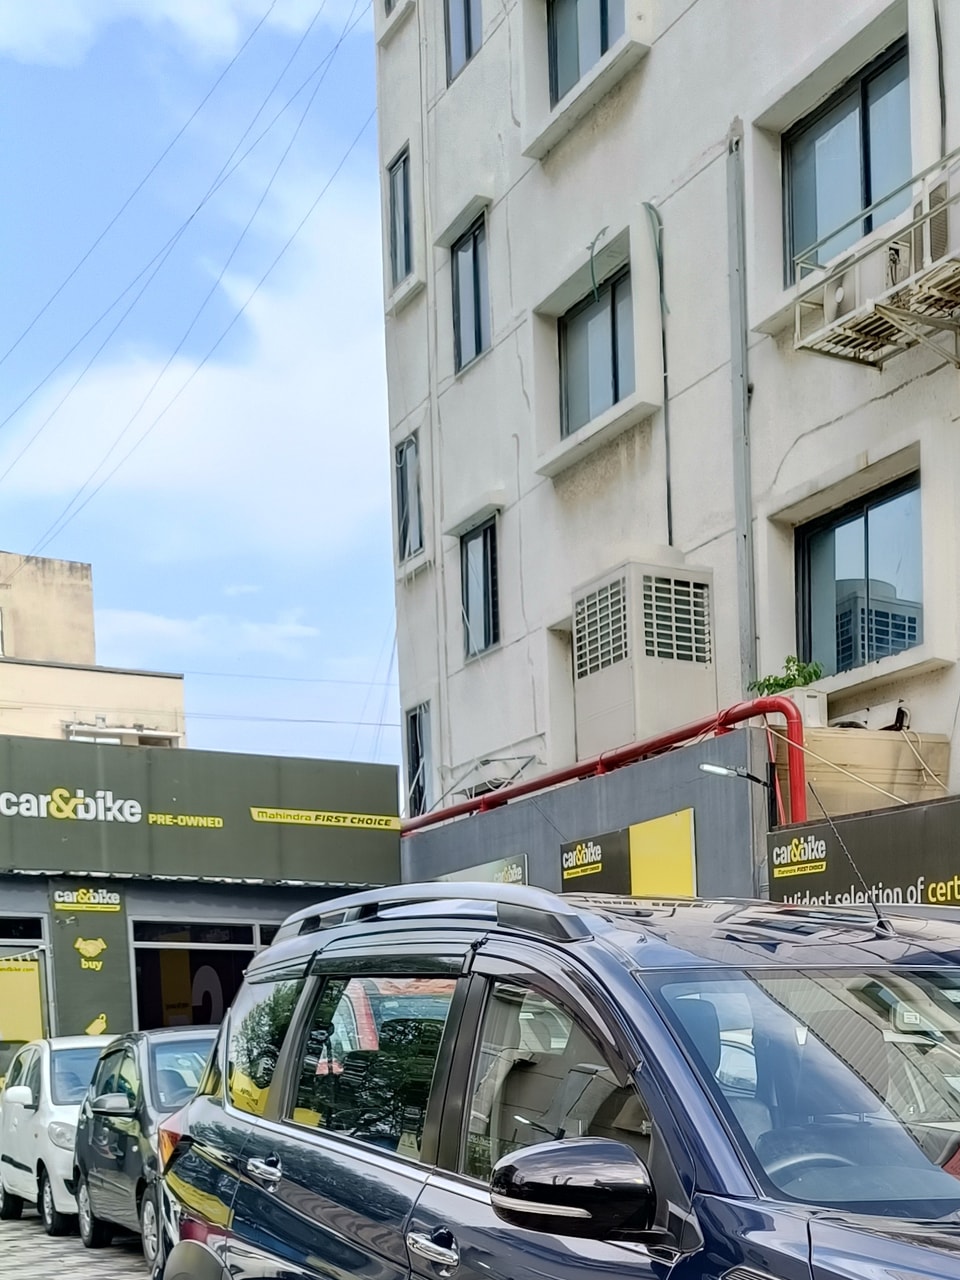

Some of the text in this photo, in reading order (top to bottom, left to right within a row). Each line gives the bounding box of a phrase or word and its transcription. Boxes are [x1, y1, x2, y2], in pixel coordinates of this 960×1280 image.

[0, 788, 142, 823] car&bike
[148, 813, 224, 828] PRE-OWNED
[257, 811, 392, 826] Mahindra FIRST CHOICE
[562, 841, 602, 868] car&bike
[773, 836, 826, 865] car&bike
[54, 889, 120, 904] car&bike
[906, 876, 924, 904] of
[81, 958, 103, 971] buy
